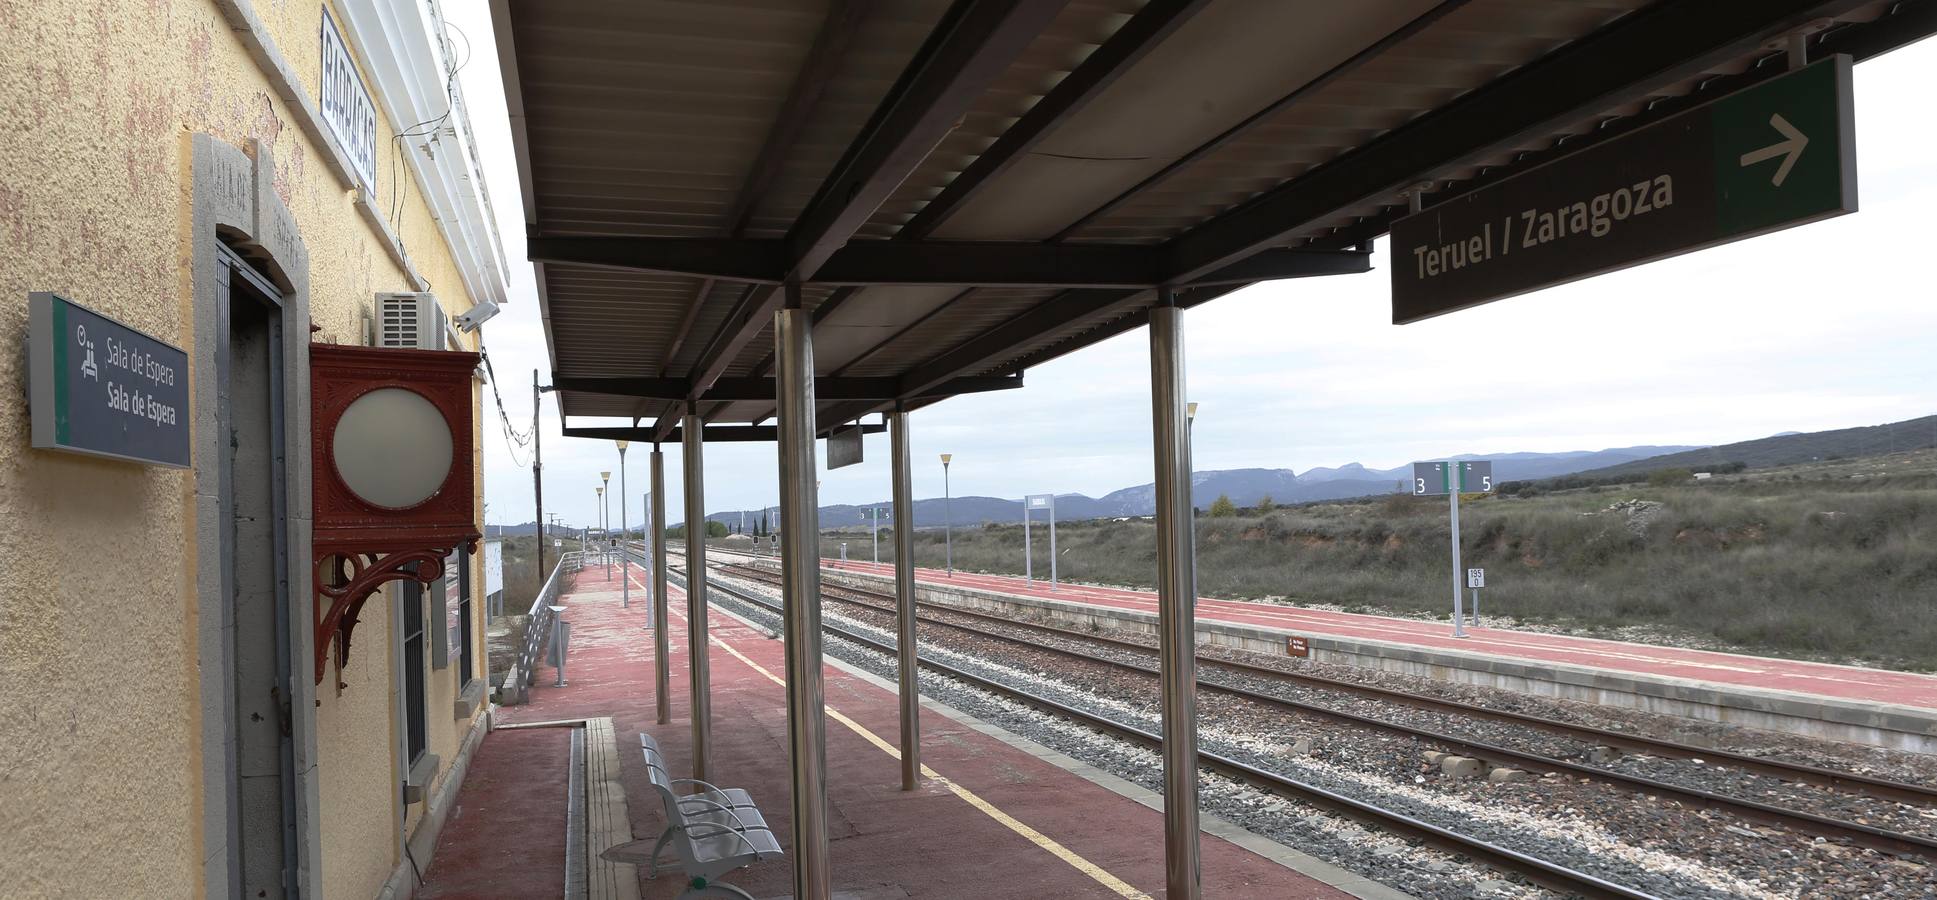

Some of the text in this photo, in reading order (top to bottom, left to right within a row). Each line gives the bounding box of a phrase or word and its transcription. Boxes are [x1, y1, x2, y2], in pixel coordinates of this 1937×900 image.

[325, 30, 374, 181] BARRACAS
[1413, 174, 1673, 280] Teruel / Zaragoza
[107, 337, 174, 387] Sala de Espera
[108, 381, 176, 427] Sala de Espera
[1416, 478, 1425, 493] 3
[1482, 476, 1491, 491] 5
[1470, 569, 1482, 578] 195
